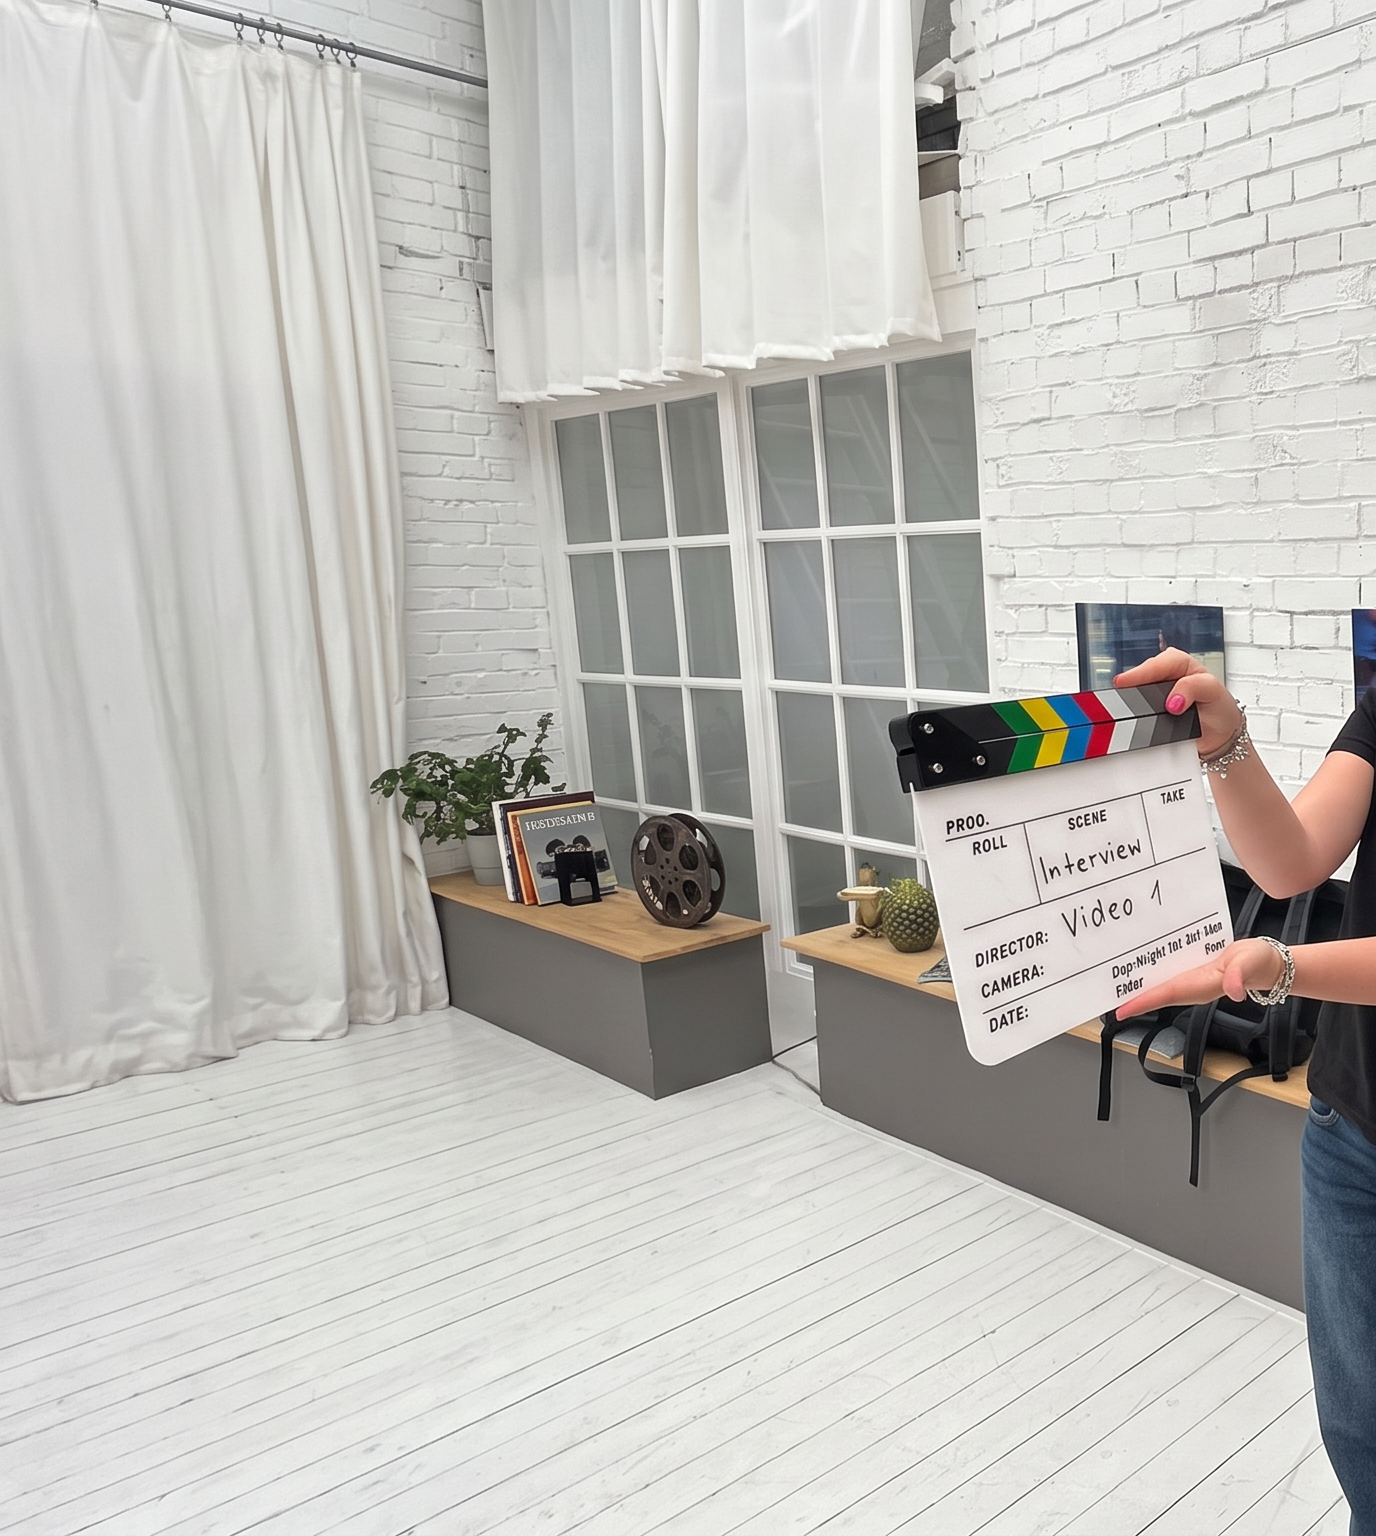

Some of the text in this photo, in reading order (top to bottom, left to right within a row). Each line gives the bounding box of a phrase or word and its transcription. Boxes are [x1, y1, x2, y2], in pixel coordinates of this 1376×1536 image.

[1160, 788, 1186, 805] TAKE
[1067, 809, 1108, 831] SCENE
[972, 836, 1008, 856] ROLL
[1039, 838, 1142, 884] Interview
[1061, 880, 1162, 937] Video 1
[974, 932, 1050, 968] DIRECTOR:
[980, 965, 1045, 999] CAMERA:
[988, 1006, 1030, 1034] DATE:
